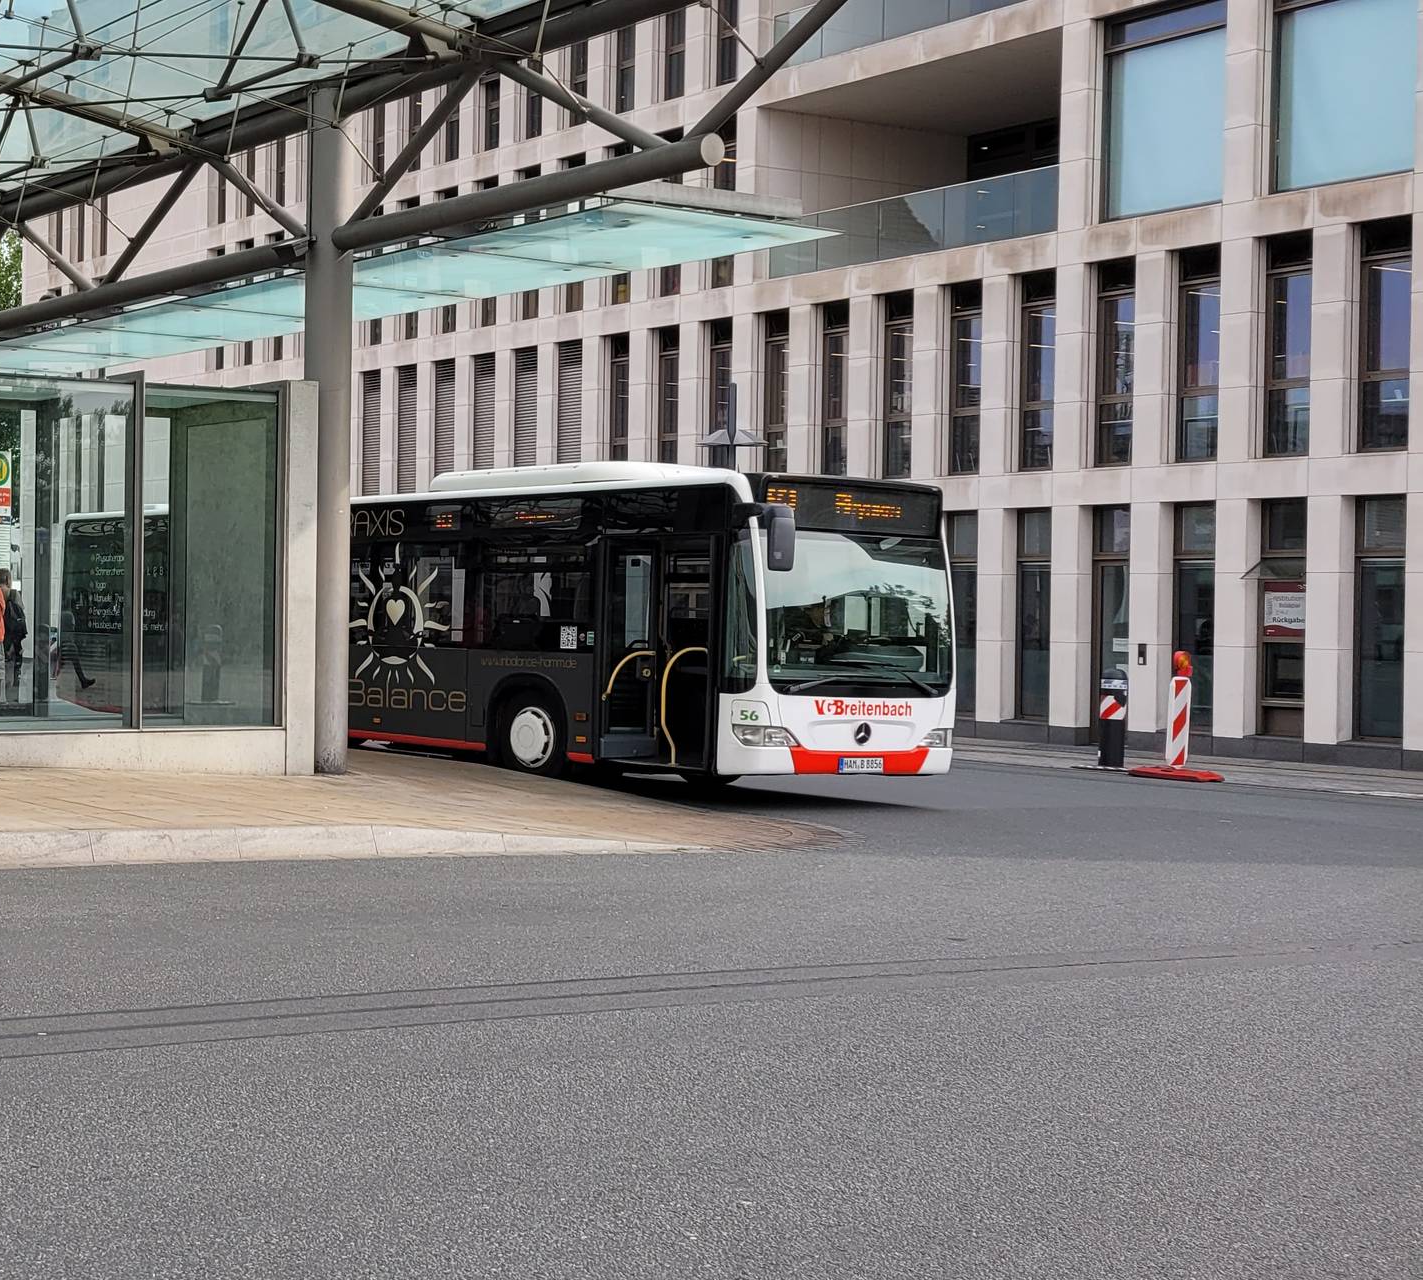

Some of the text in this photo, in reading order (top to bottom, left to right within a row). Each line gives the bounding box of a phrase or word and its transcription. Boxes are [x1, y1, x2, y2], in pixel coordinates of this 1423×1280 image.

[739, 709, 759, 721] 56
[843, 757, 883, 770] HAM B 8856
